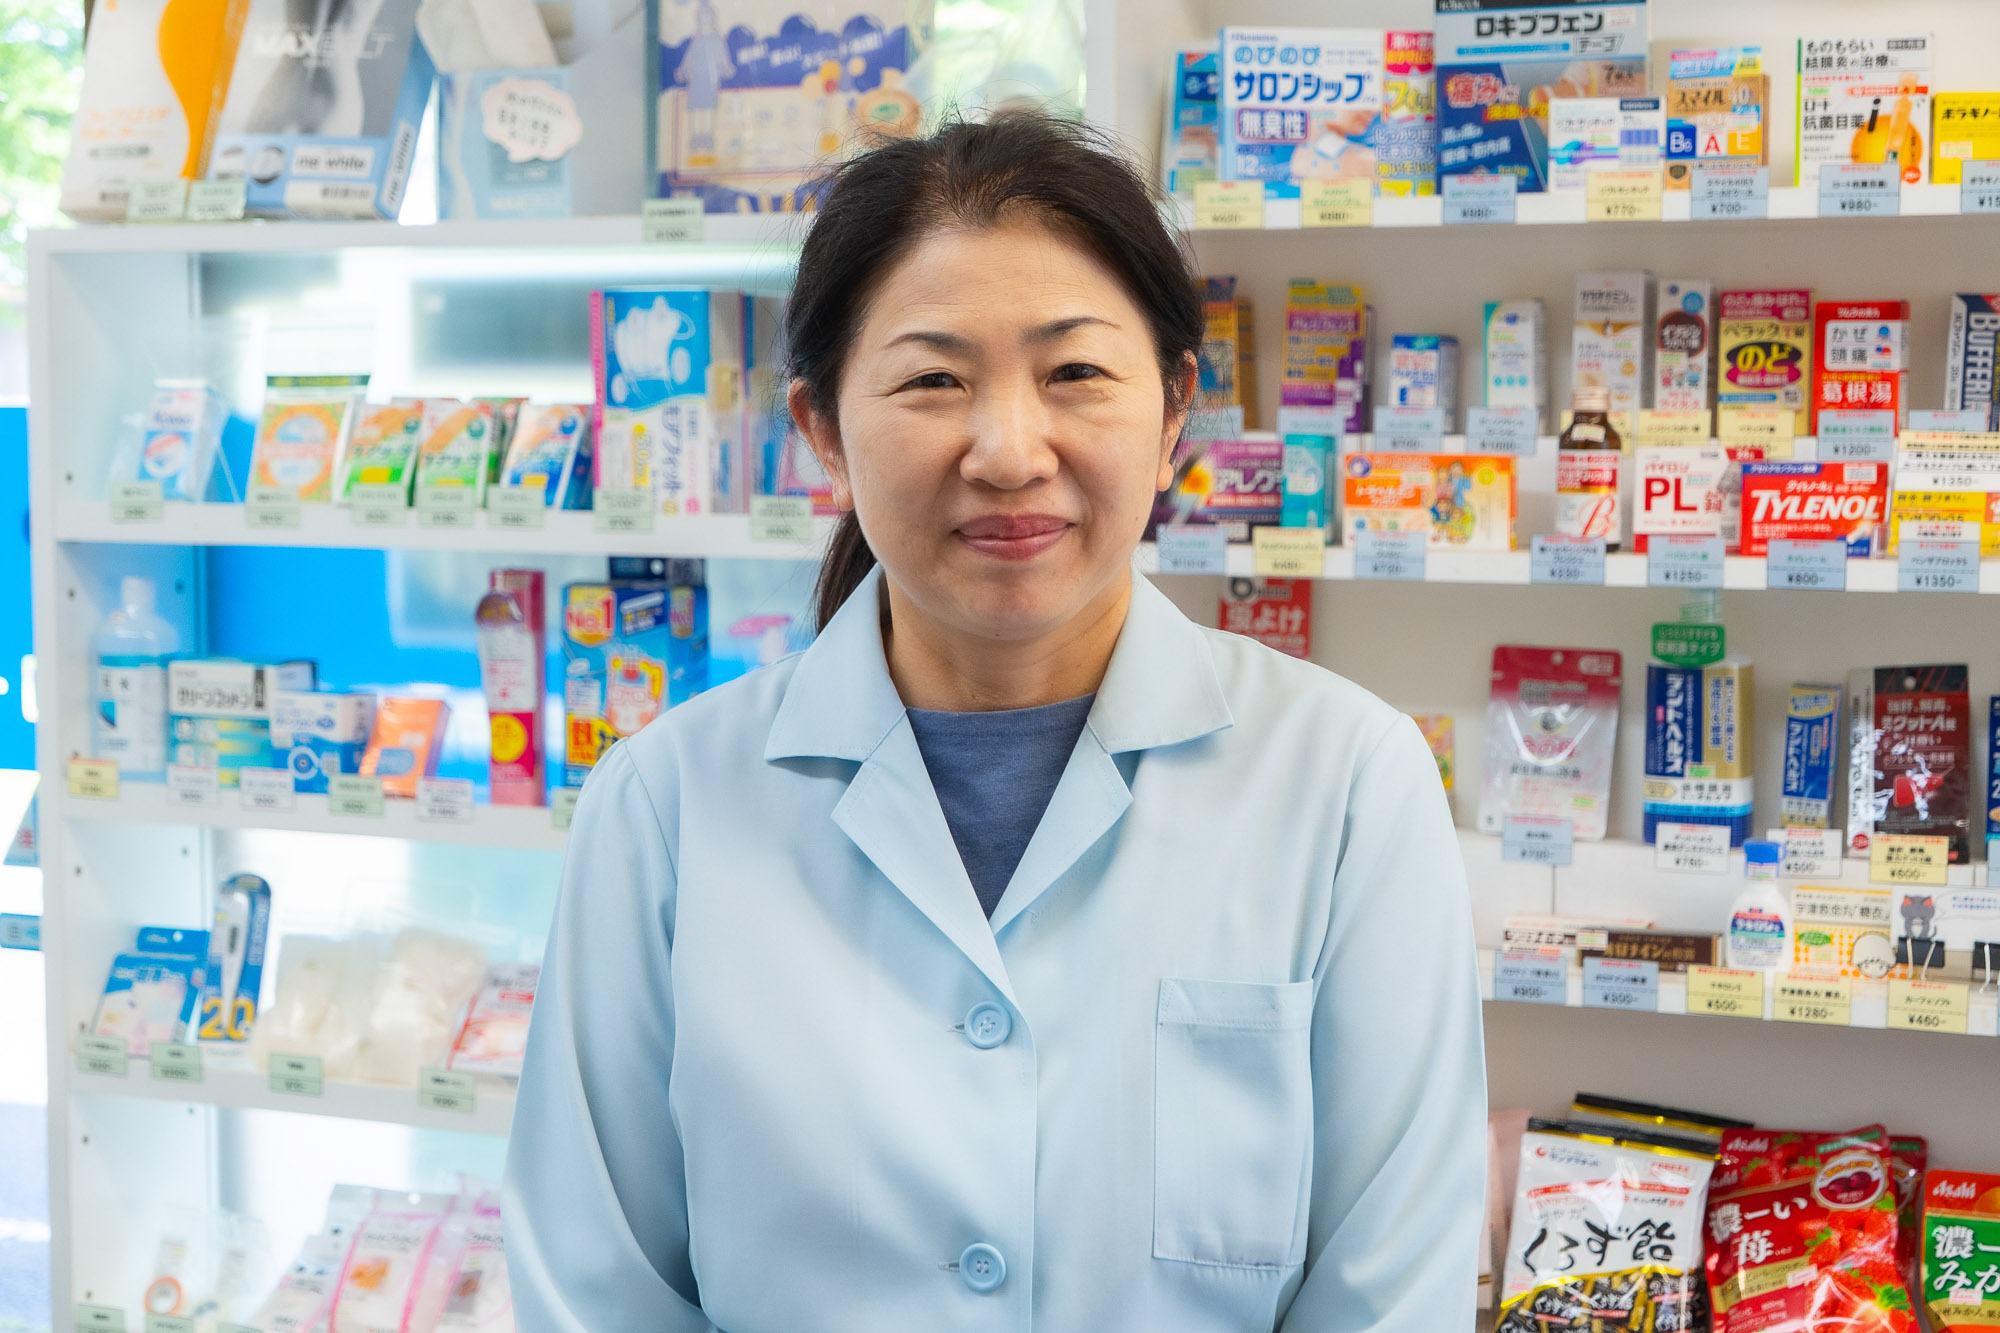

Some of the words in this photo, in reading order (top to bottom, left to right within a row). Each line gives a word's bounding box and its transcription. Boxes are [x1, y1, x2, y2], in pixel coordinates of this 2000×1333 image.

[1476, 13, 1603, 37] ロキプフェン
[1233, 45, 1321, 65] のびのび
[1806, 40, 1874, 59] ものもらい
[1234, 70, 1372, 102] サロンシップ
[1239, 111, 1305, 138] 無臭性
[1803, 115, 1865, 128] 抗菌目薬
[1704, 133, 1722, 154] A
[1737, 132, 1750, 151] E
[1831, 326, 1869, 343] かぜ
[1736, 344, 1793, 374] のど
[1821, 380, 1893, 405] 葛根湯
[1643, 477, 1698, 512] PL
[1750, 489, 1881, 523] TYLENOL
[1726, 1136, 1769, 1153] Asahi
[1931, 1180, 1976, 1199] Asahi
[1707, 1196, 1809, 1244] 濃ーい
[1522, 1218, 1676, 1277] くろず飴
[1734, 1229, 1774, 1266] 苺
